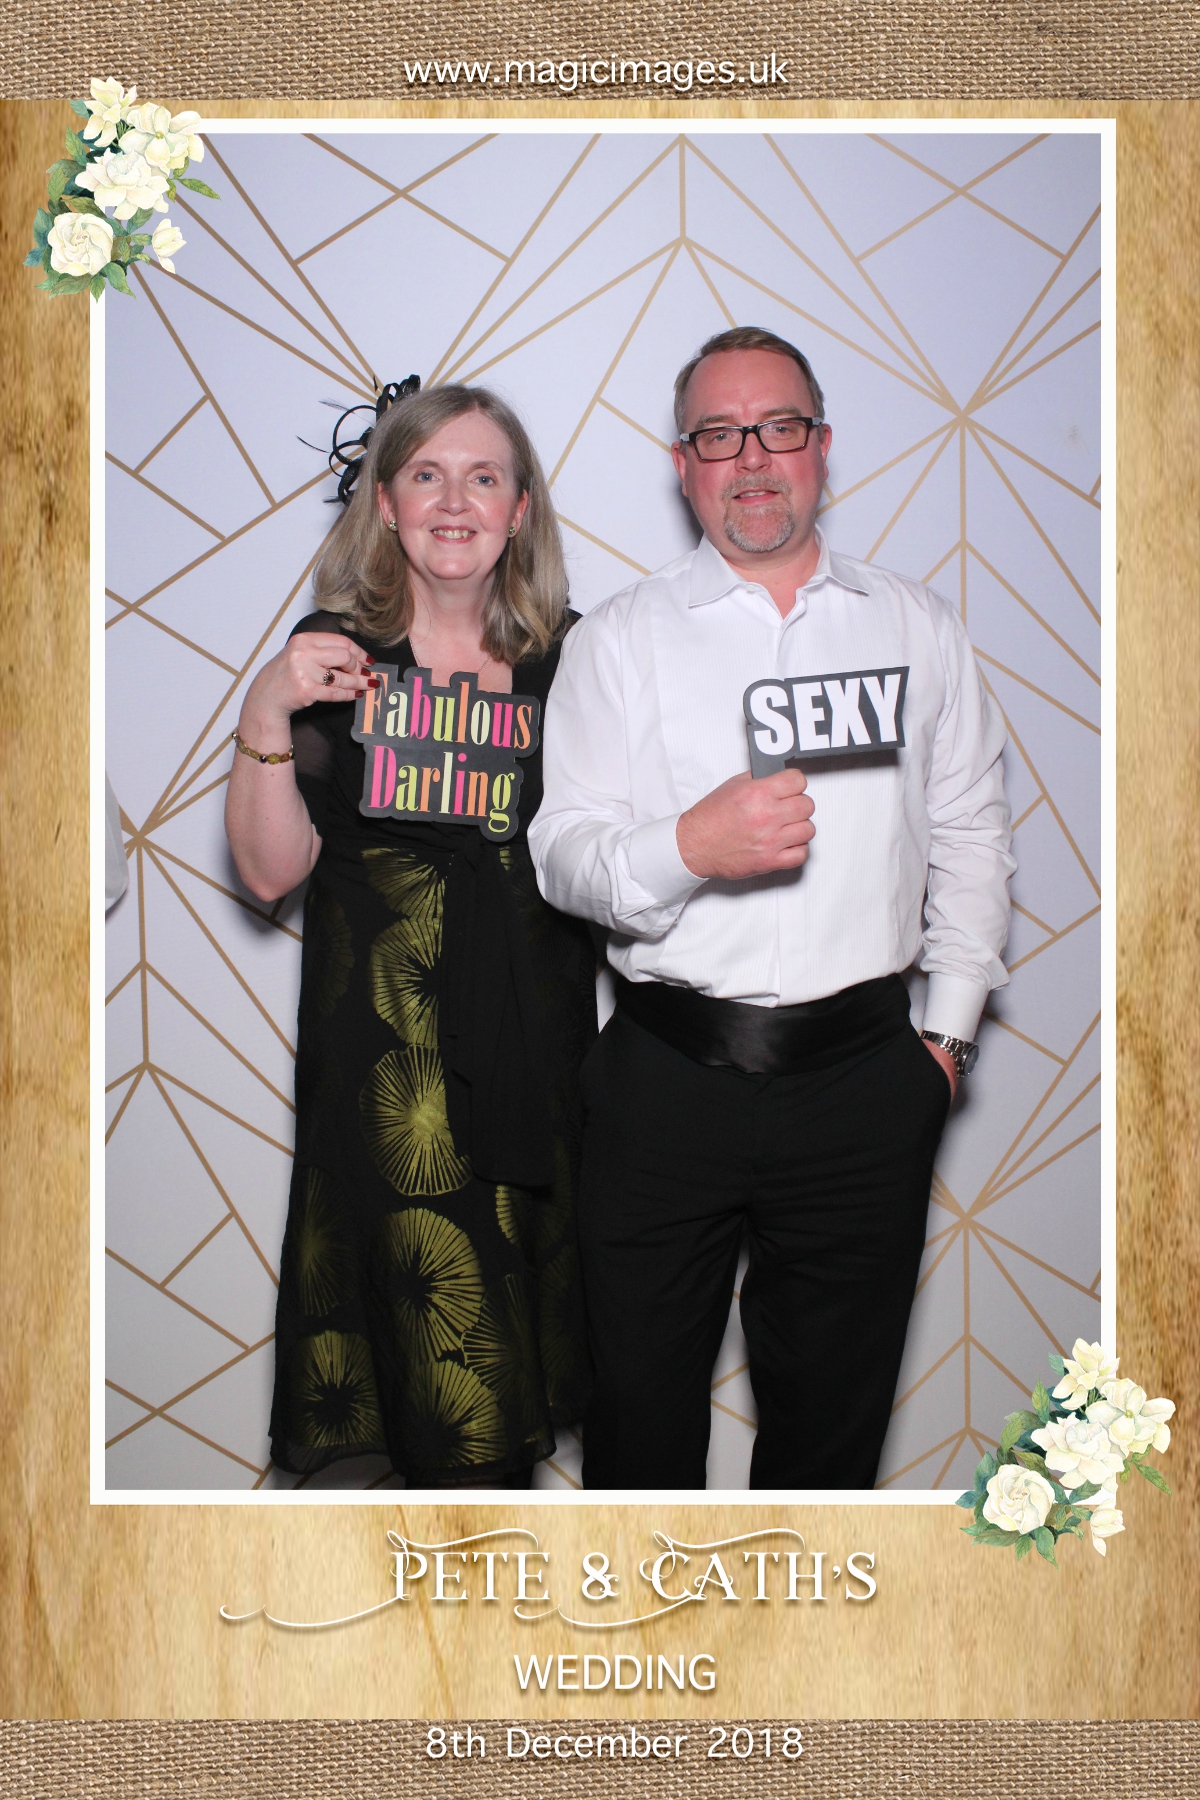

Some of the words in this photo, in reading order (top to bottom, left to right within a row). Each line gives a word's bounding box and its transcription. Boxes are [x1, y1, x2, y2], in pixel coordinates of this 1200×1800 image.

[360, 672, 533, 750] Fabulous
[750, 673, 902, 756] SEXY
[367, 745, 516, 833] Darling
